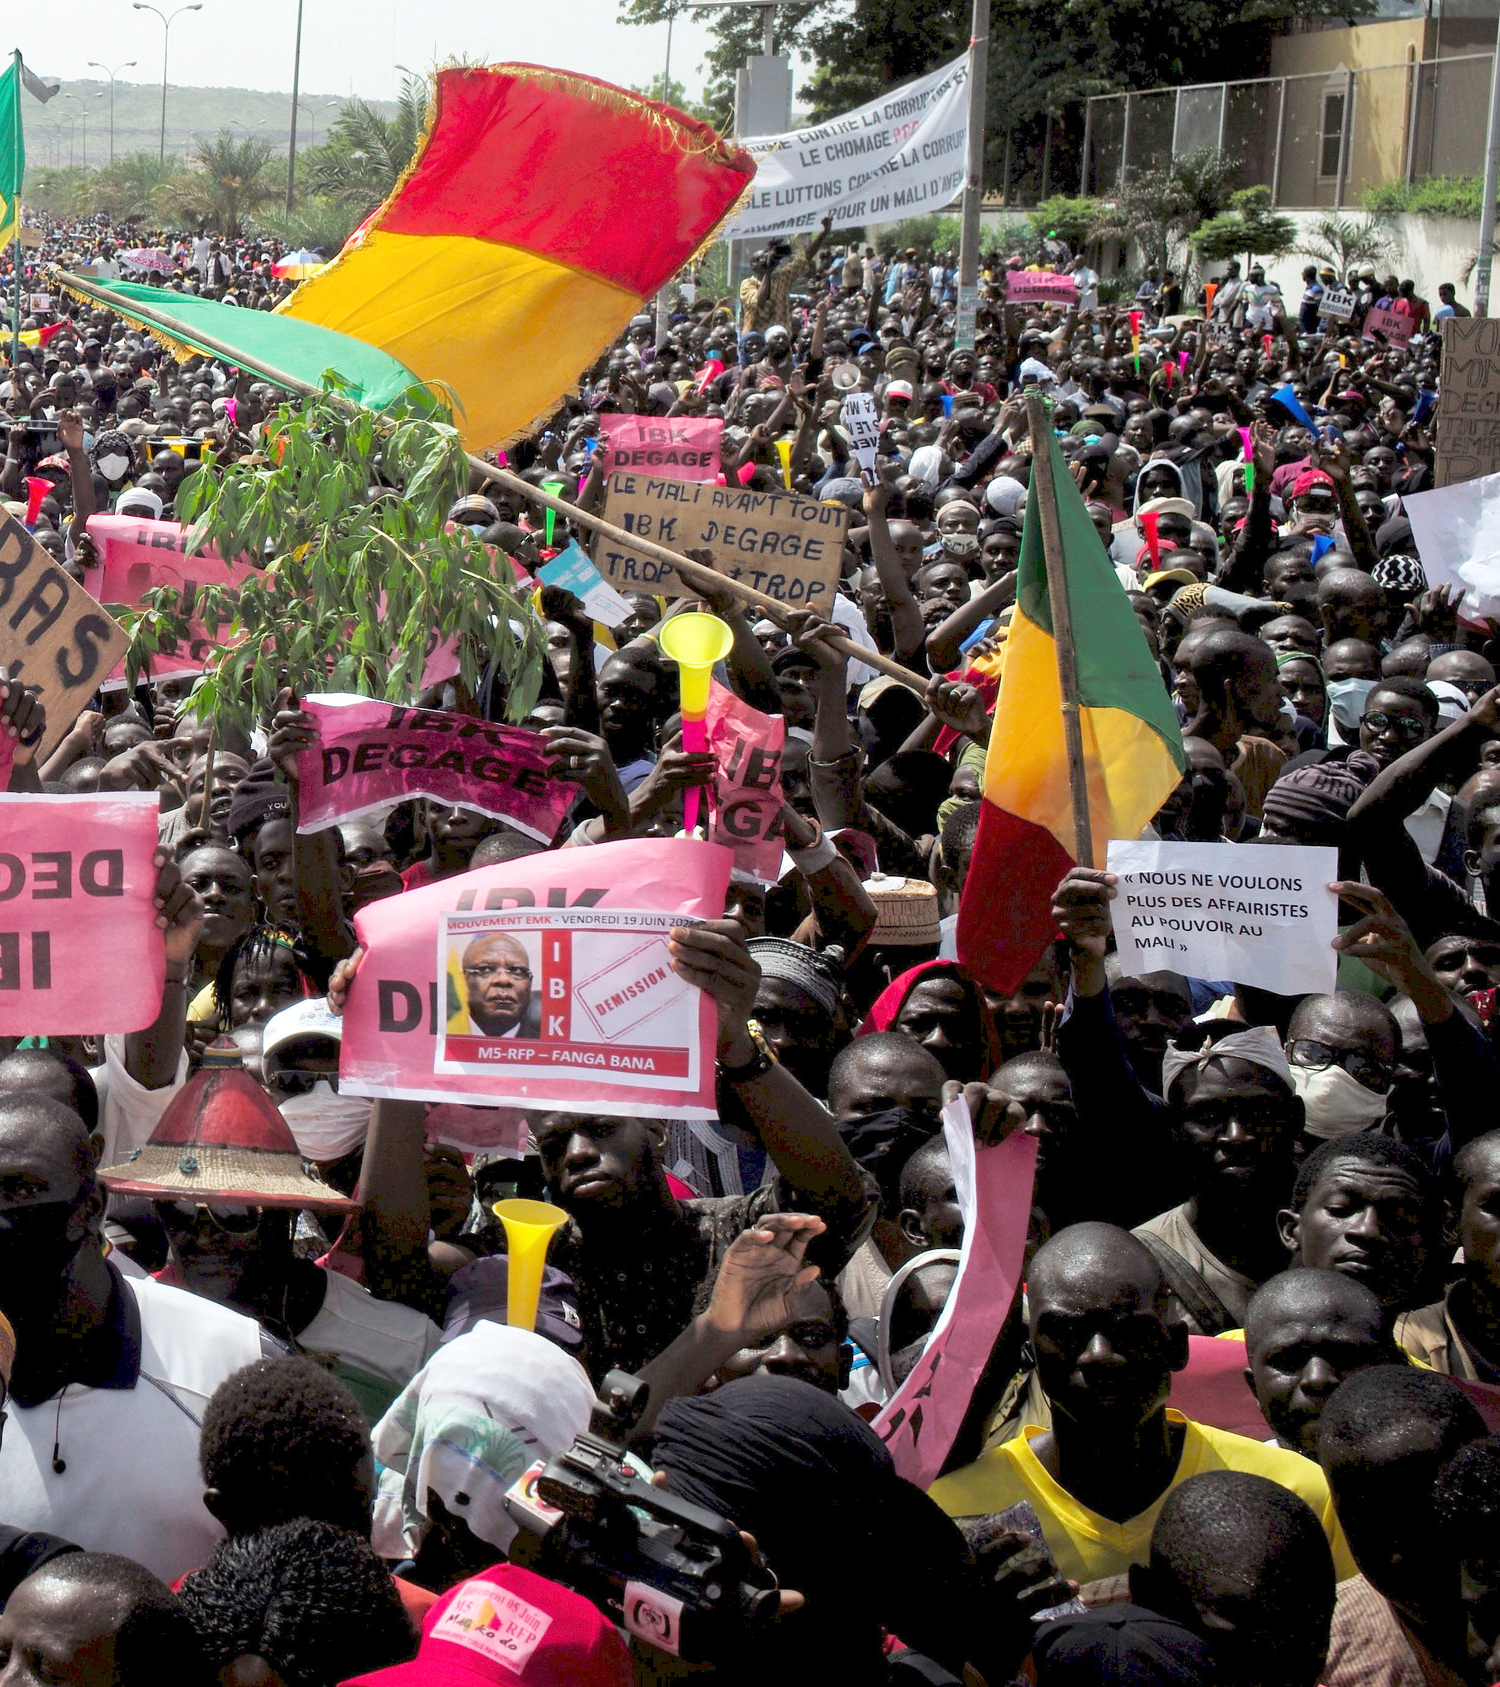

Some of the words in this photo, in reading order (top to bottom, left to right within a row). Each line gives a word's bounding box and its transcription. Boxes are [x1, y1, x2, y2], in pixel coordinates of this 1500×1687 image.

[750, 140, 792, 154] ORME
[797, 121, 859, 145] CONTRE
[861, 108, 881, 127] LA
[884, 81, 952, 121] CORRUPTION
[952, 65, 970, 87] ET
[799, 149, 821, 168] LE
[826, 130, 892, 162] CHOMAGE
[775, 179, 842, 207] LUTTONS
[901, 150, 920, 169] LA
[923, 128, 966, 157] CORRUP
[826, 200, 866, 222] POUR
[870, 195, 890, 214] UN
[893, 186, 927, 209] MALI
[1326, 291, 1354, 307] IBK
[1382, 317, 1401, 330] IBK
[1443, 318, 1500, 356] MO
[1443, 389, 1500, 415] DEG
[638, 426, 690, 444] IBK
[614, 449, 713, 468] DEGAGE
[613, 476, 636, 496] LE
[712, 490, 783, 516] AVANT
[790, 498, 846, 527] TOUT
[623, 512, 678, 543] IBK
[700, 520, 825, 562] DEGAGE
[605, 552, 674, 583] TROP
[749, 570, 826, 604] TROP
[384, 705, 502, 747] IBK
[320, 741, 549, 798] DEGAGE
[1139, 871, 1187, 886] NOUS
[1191, 873, 1214, 887] NE
[1218, 875, 1303, 892] VOULONS
[1126, 895, 1167, 909] PLUS
[1171, 896, 1203, 909] DES
[1207, 897, 1309, 919] AFFAIRISTES
[447, 916, 523, 930] MOUVEMENT
[526, 915, 552, 925] EMK
[562, 915, 620, 925] VENDREDI
[623, 916, 637, 926] 19
[639, 916, 666, 927] JUIN
[1131, 915, 1155, 928] AU
[1159, 916, 1234, 934] POUVOIR
[1238, 924, 1263, 938] AU
[1135, 936, 1175, 950] MALI
[595, 966, 667, 1016] DEMISSION
[477, 1046, 536, 1061] M5-RFP
[552, 1049, 606, 1066] FANGA
[610, 1055, 656, 1071] BANA
[505, 1620, 537, 1644] RFP
[518, 1608, 541, 1632] Juin
